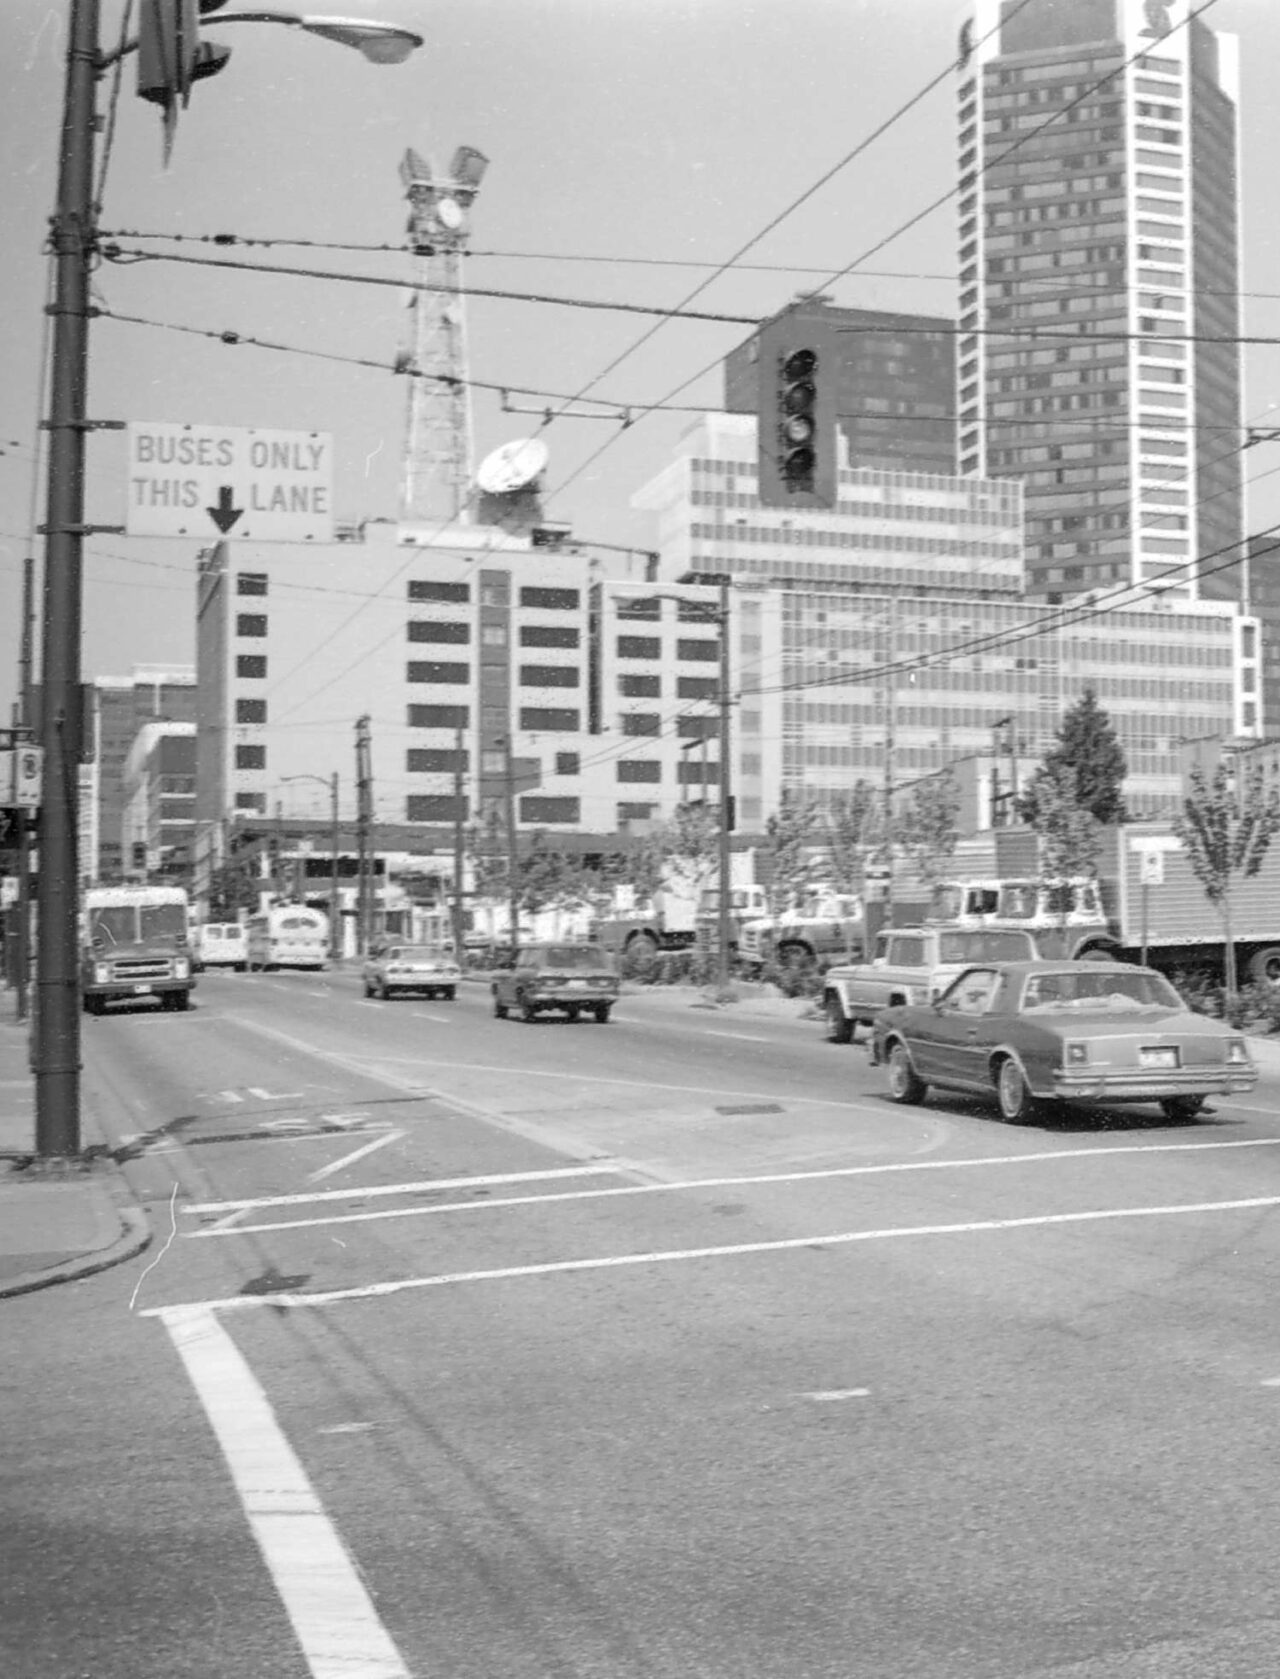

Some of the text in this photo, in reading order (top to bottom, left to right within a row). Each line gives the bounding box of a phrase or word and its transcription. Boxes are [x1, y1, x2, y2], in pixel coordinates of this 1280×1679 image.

[136, 434, 325, 471] BUSES ONLY
[132, 477, 327, 514] THIS LANE
